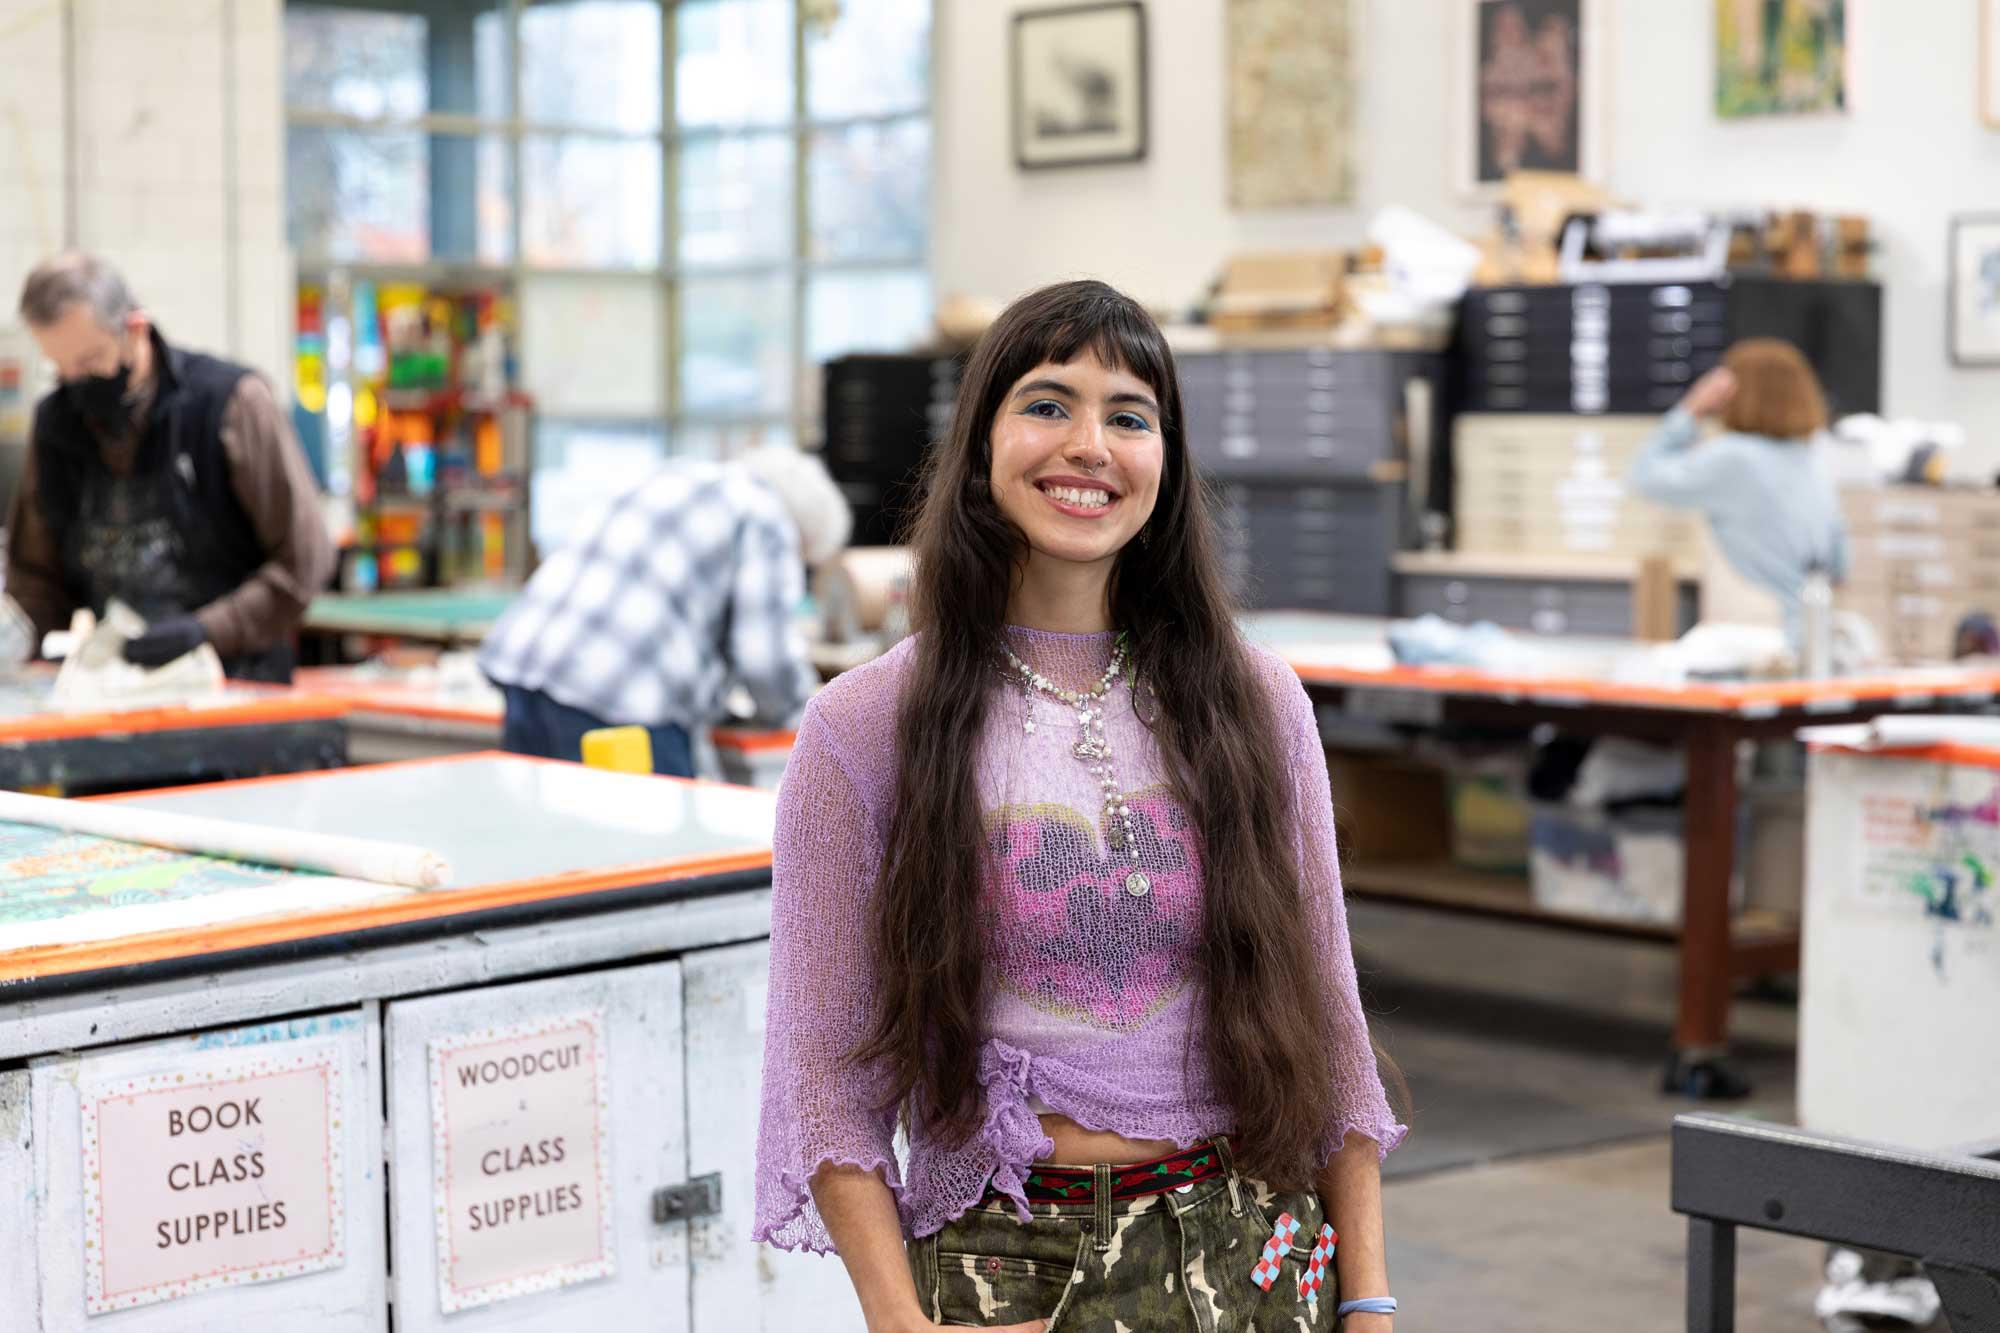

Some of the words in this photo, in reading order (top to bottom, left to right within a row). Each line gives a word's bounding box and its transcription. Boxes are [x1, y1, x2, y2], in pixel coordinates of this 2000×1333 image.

[457, 1044, 582, 1088] WOODCUT
[168, 1098, 262, 1138] BOOK
[167, 1151, 265, 1192] CLASS
[480, 1136, 566, 1177] CLASS
[156, 1200, 287, 1250] SUPPLIES
[468, 1182, 582, 1232] SUPPLIES
